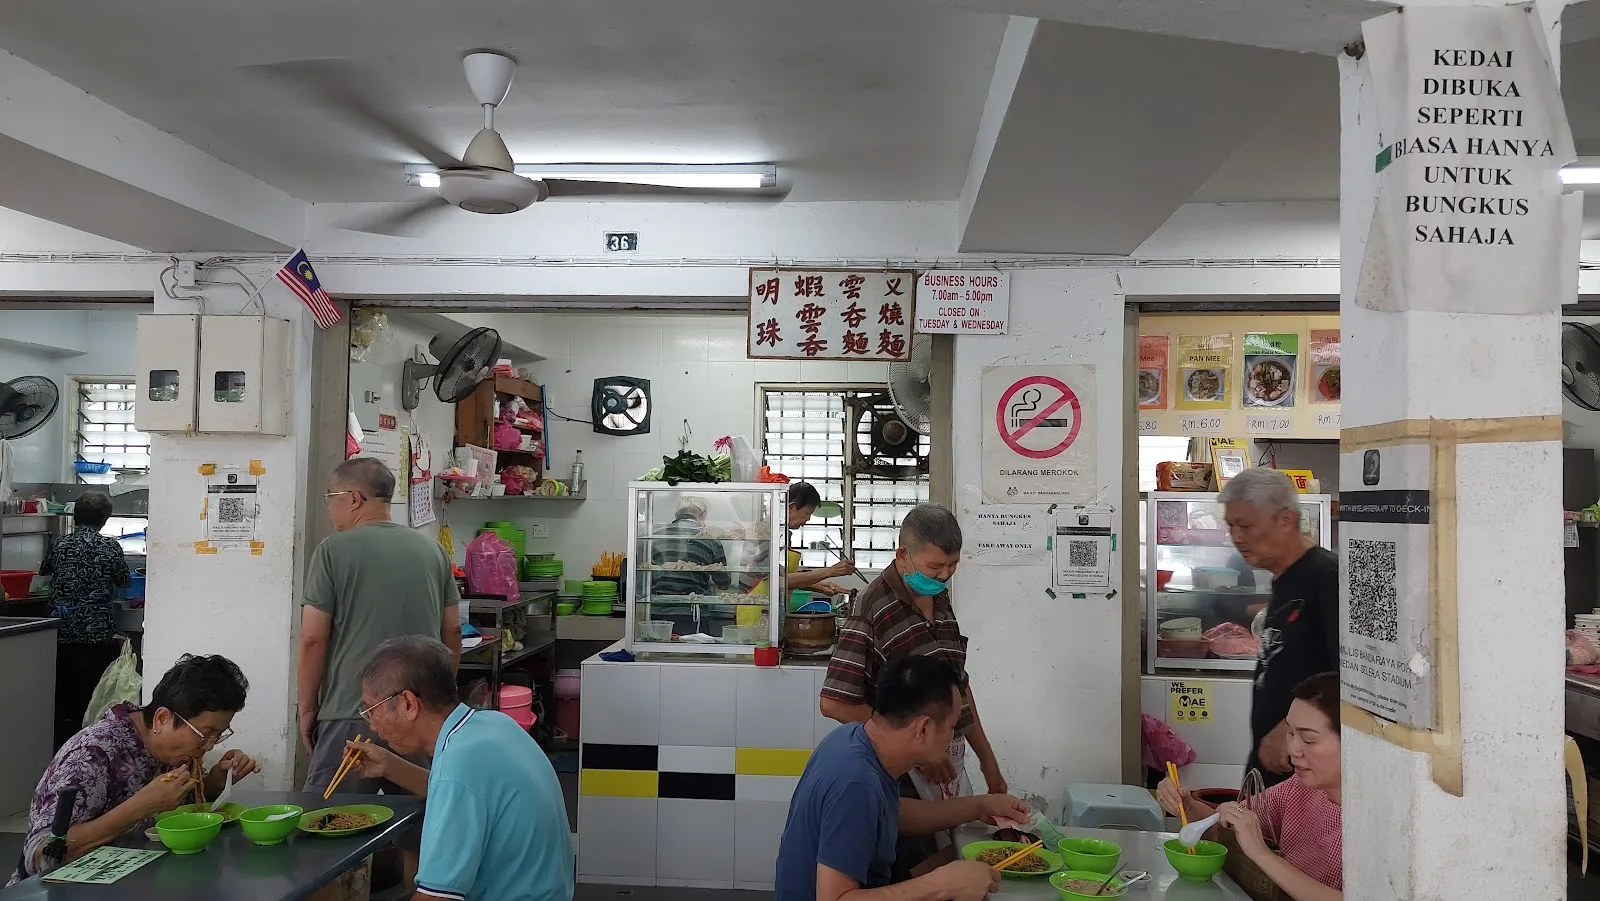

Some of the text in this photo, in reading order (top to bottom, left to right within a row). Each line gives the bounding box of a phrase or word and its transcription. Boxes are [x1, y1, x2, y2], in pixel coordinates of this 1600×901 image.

[1433, 49, 1514, 68] KEDAI
[1422, 78, 1521, 97] DIBUKA
[1417, 107, 1524, 127] SEPERTI
[1394, 136, 1555, 159] BIASA HANYA
[1424, 166, 1514, 186] UNTUK
[1405, 195, 1529, 216] BUNGKUS
[610, 235, 629, 251] 36
[1415, 224, 1515, 245] SAHAJA
[924, 275, 965, 287] BUSINESS
[755, 276, 784, 348] 明珠
[938, 307, 966, 317] CLOSED
[969, 307, 980, 317] ON
[919, 319, 1004, 330] TUESDAY & WEDNESDAY
[1389, 504, 1396, 513] TO
[1360, 664, 1381, 680] SELERA
[1381, 671, 1412, 690] STADIUM
[1179, 695, 1206, 707] MAE
